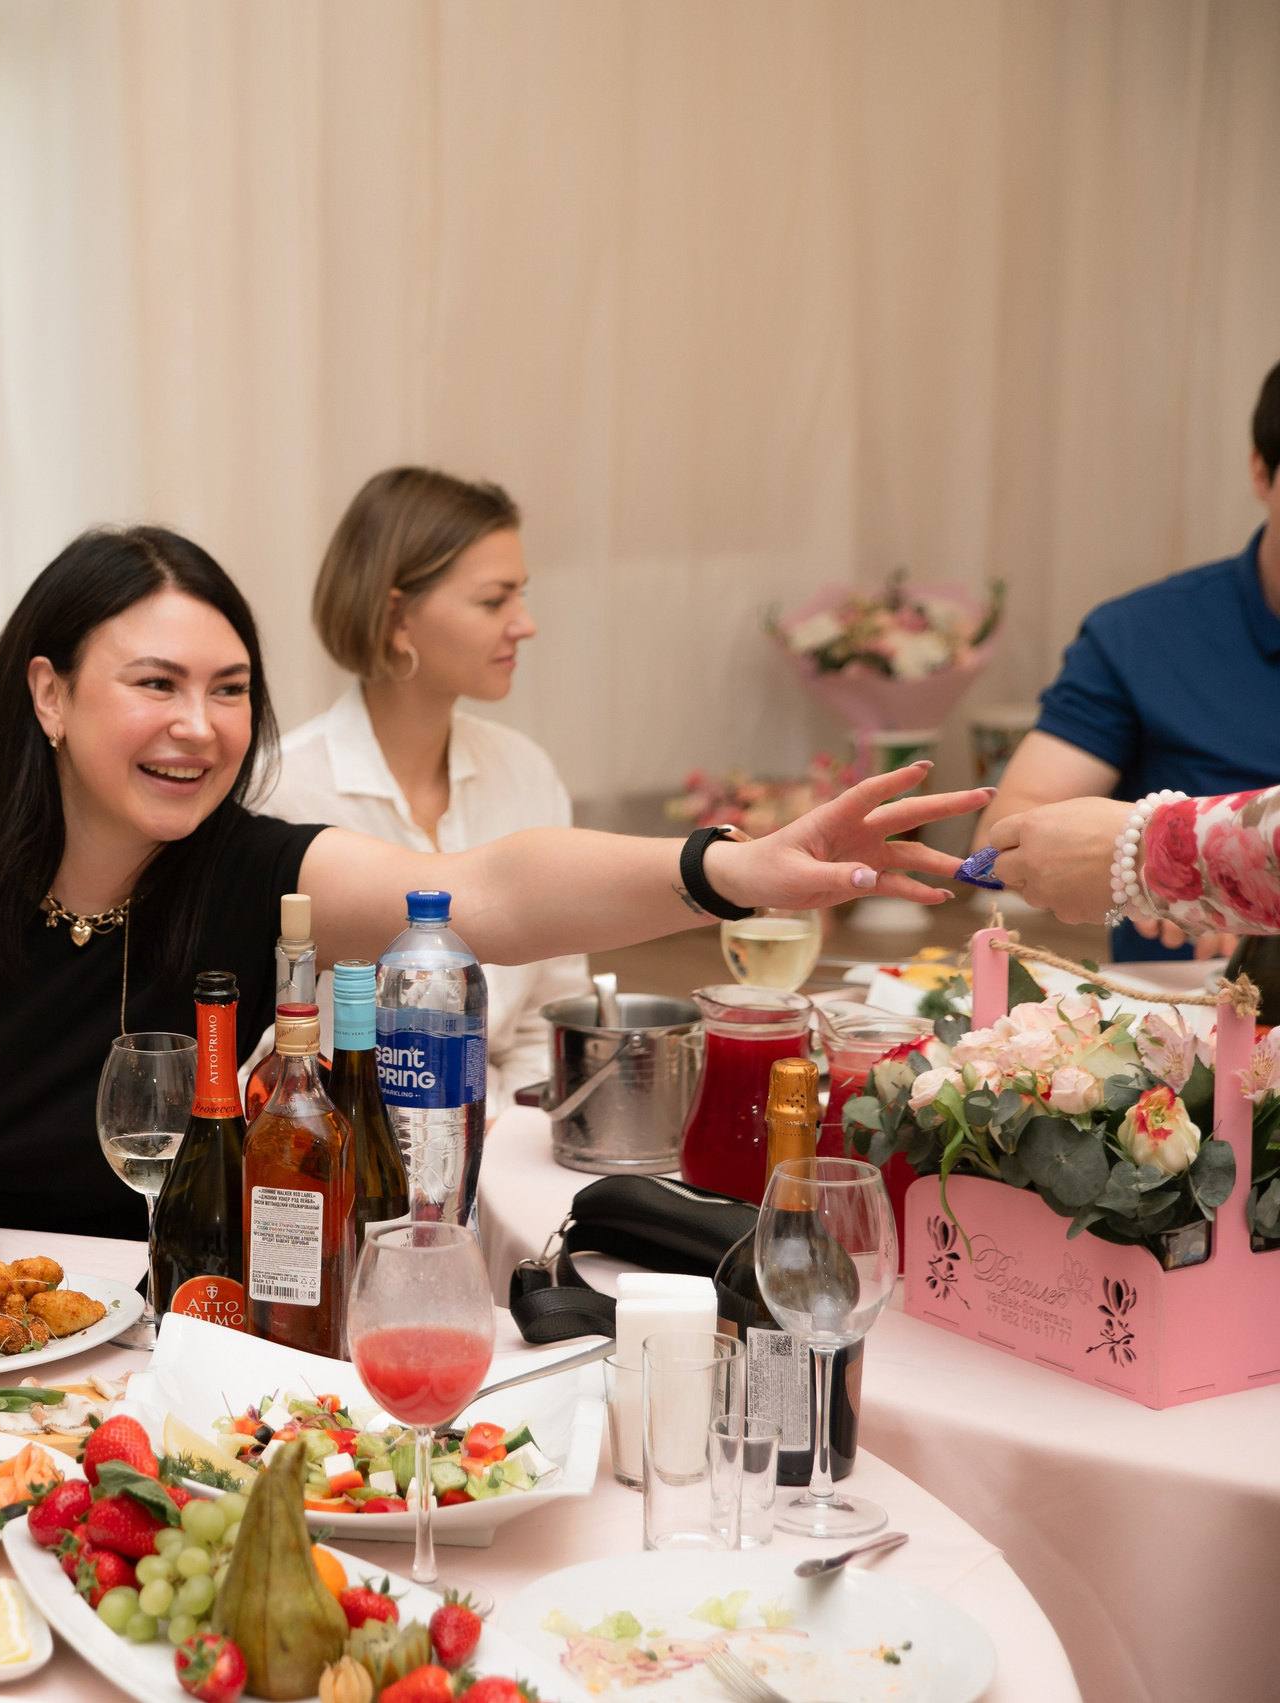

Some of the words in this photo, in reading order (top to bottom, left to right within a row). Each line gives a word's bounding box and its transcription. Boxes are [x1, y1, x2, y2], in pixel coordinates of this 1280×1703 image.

[208, 1014, 218, 1052] PRIMO
[209, 1054, 219, 1085] ATTO
[377, 1065, 436, 1089] PRING
[194, 1102, 236, 1114] Prosecco
[186, 1298, 239, 1313] ATTO
